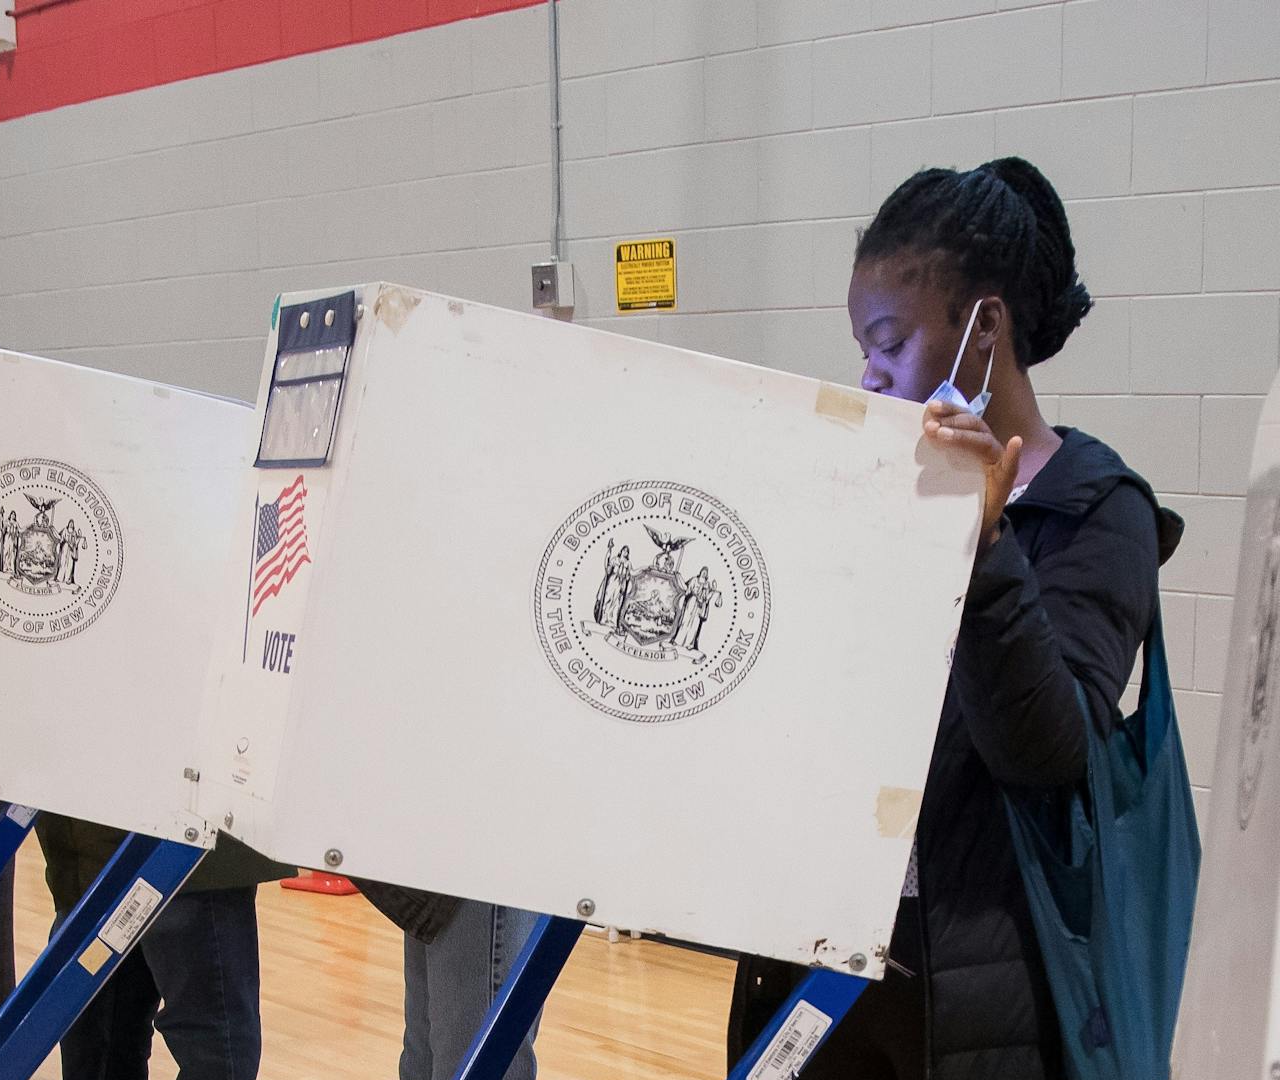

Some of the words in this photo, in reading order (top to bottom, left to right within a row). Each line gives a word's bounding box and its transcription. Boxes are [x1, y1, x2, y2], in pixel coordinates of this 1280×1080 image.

[621, 242, 669, 261] WARNING
[19, 467, 41, 481] OF
[47, 469, 114, 542] ELECTIONS
[563, 495, 635, 551] BOARD
[641, 491, 672, 509] OF
[678, 497, 760, 601] ELECTIONS
[15, 582, 53, 595] EXCELSIOR
[23, 621, 44, 633] OF
[49, 607, 84, 633] NEW
[85, 563, 114, 609] YORK
[545, 576, 563, 600] IN
[261, 629, 296, 674] VOTE
[547, 608, 572, 654] THE
[615, 640, 666, 660] EXCELSIOR
[708, 628, 755, 686] YORK
[568, 658, 615, 699] CITY
[655, 680, 705, 710] NEW
[619, 691, 648, 710] OF
